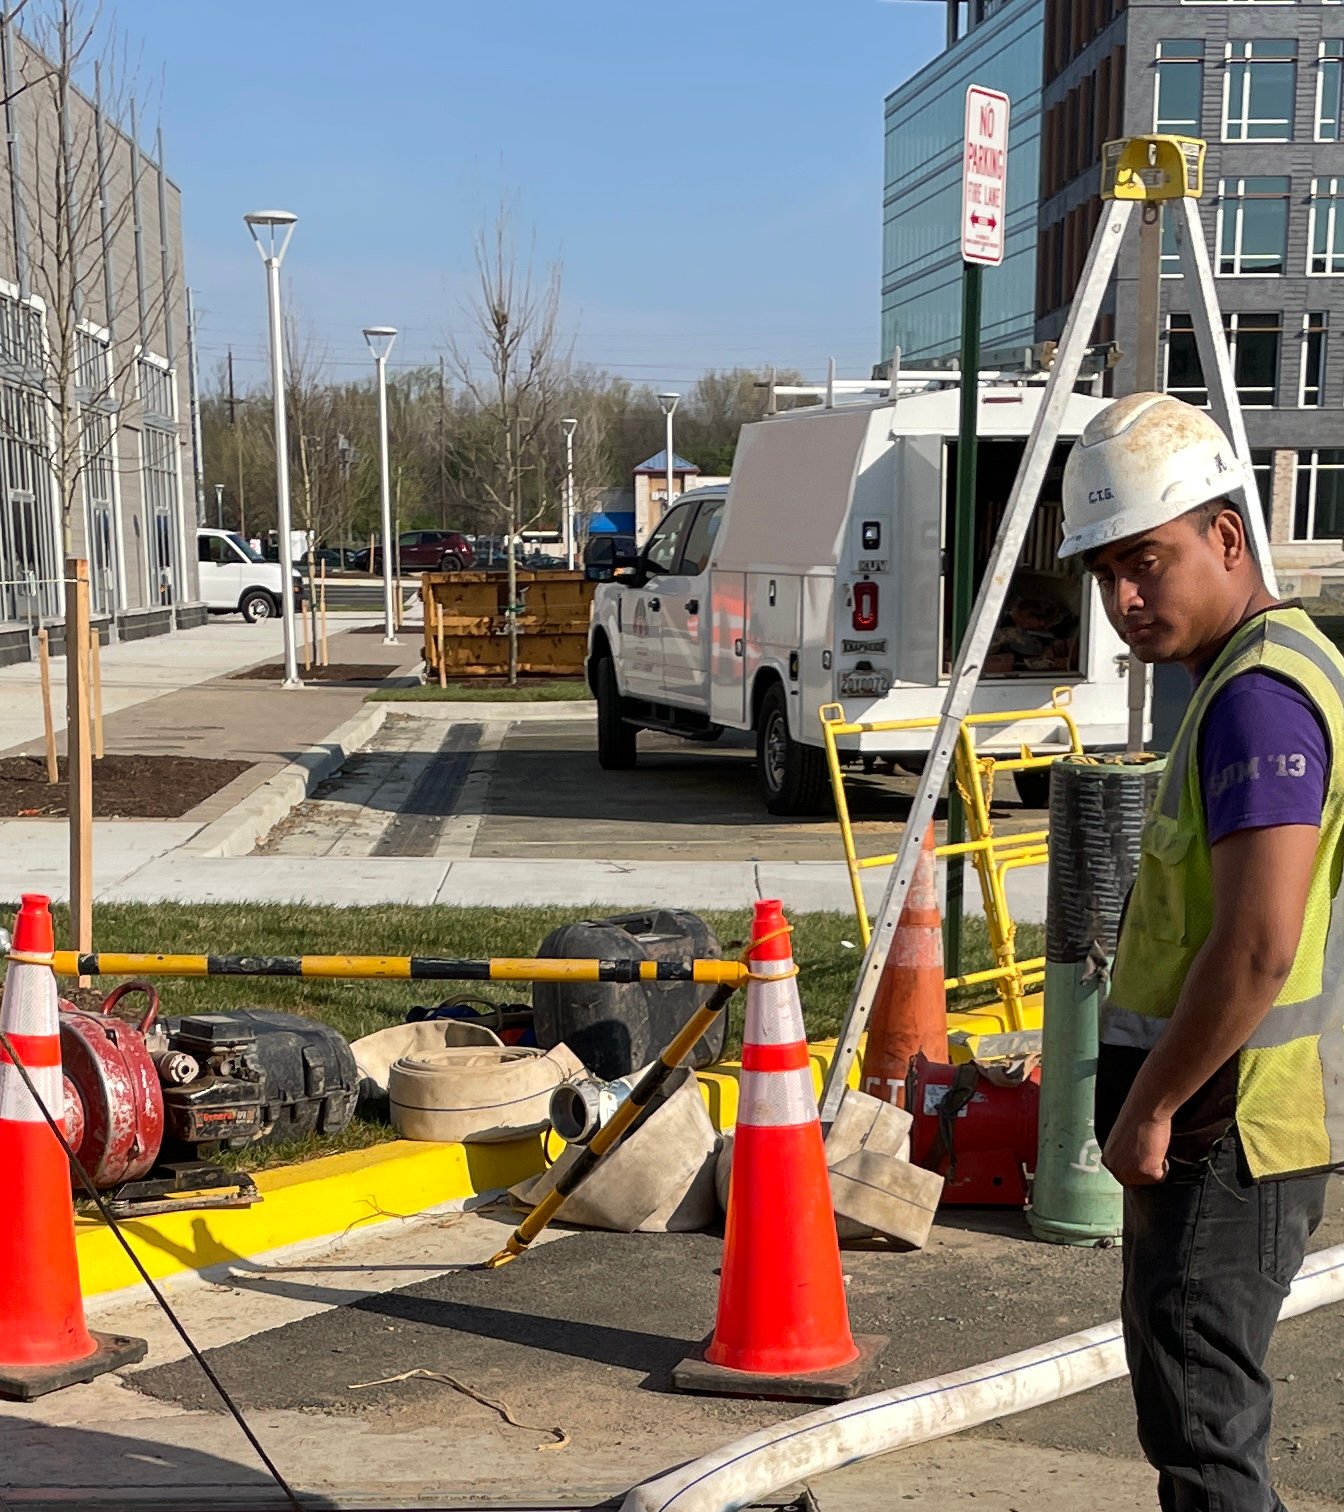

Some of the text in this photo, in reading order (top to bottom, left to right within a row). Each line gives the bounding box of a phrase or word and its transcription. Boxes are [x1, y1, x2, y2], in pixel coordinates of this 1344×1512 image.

[979, 106, 995, 138] NO
[966, 142, 1004, 180] PARKING
[1267, 753, 1307, 777] '13
